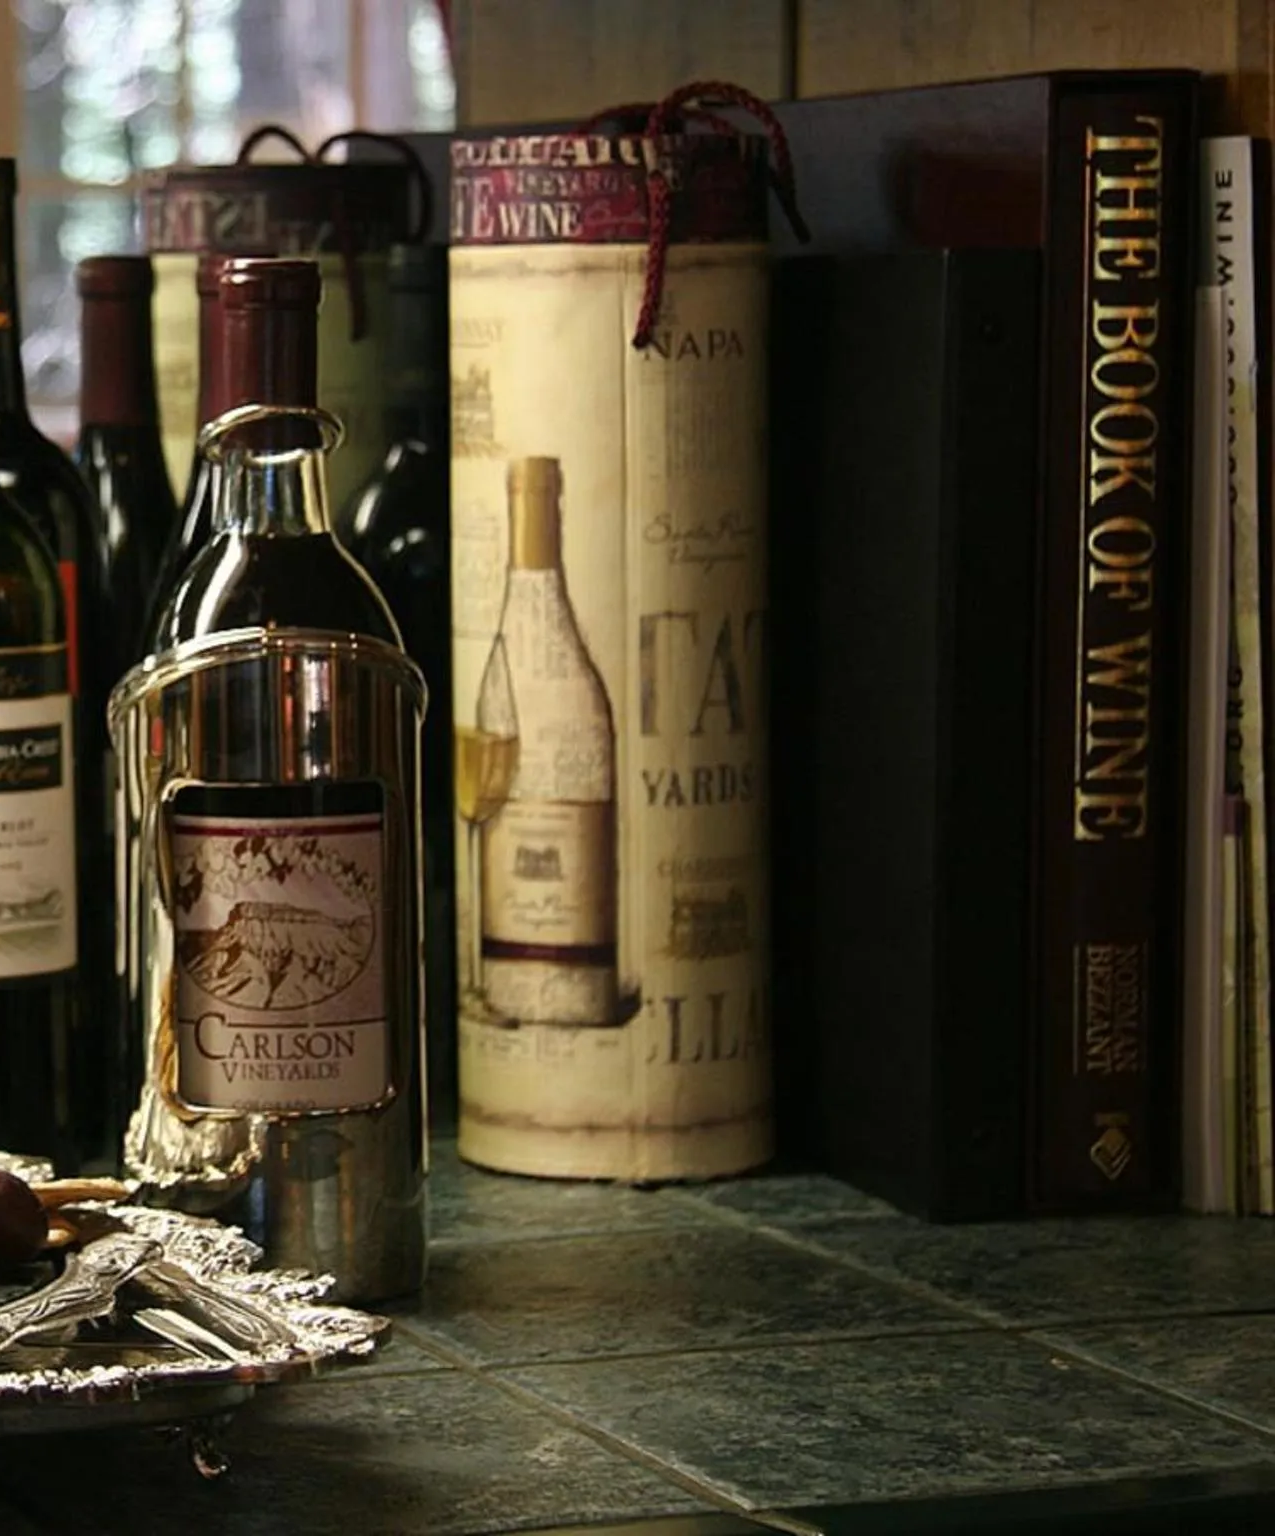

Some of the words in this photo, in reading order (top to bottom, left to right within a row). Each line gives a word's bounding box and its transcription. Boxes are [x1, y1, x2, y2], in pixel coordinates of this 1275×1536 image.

[498, 200, 585, 238] WINE
[1087, 114, 1163, 282] THE
[644, 327, 745, 362] NAPA
[1090, 300, 1159, 505] BOOK
[1087, 516, 1156, 612] OF
[641, 762, 759, 809] YARDS
[1073, 634, 1153, 842] WINE
[193, 1012, 356, 1061] CARLSON
[1086, 943, 1113, 1075] BEZZANT
[1112, 943, 1140, 1074] NORMAN
[221, 1060, 342, 1083] VINEYARDS
